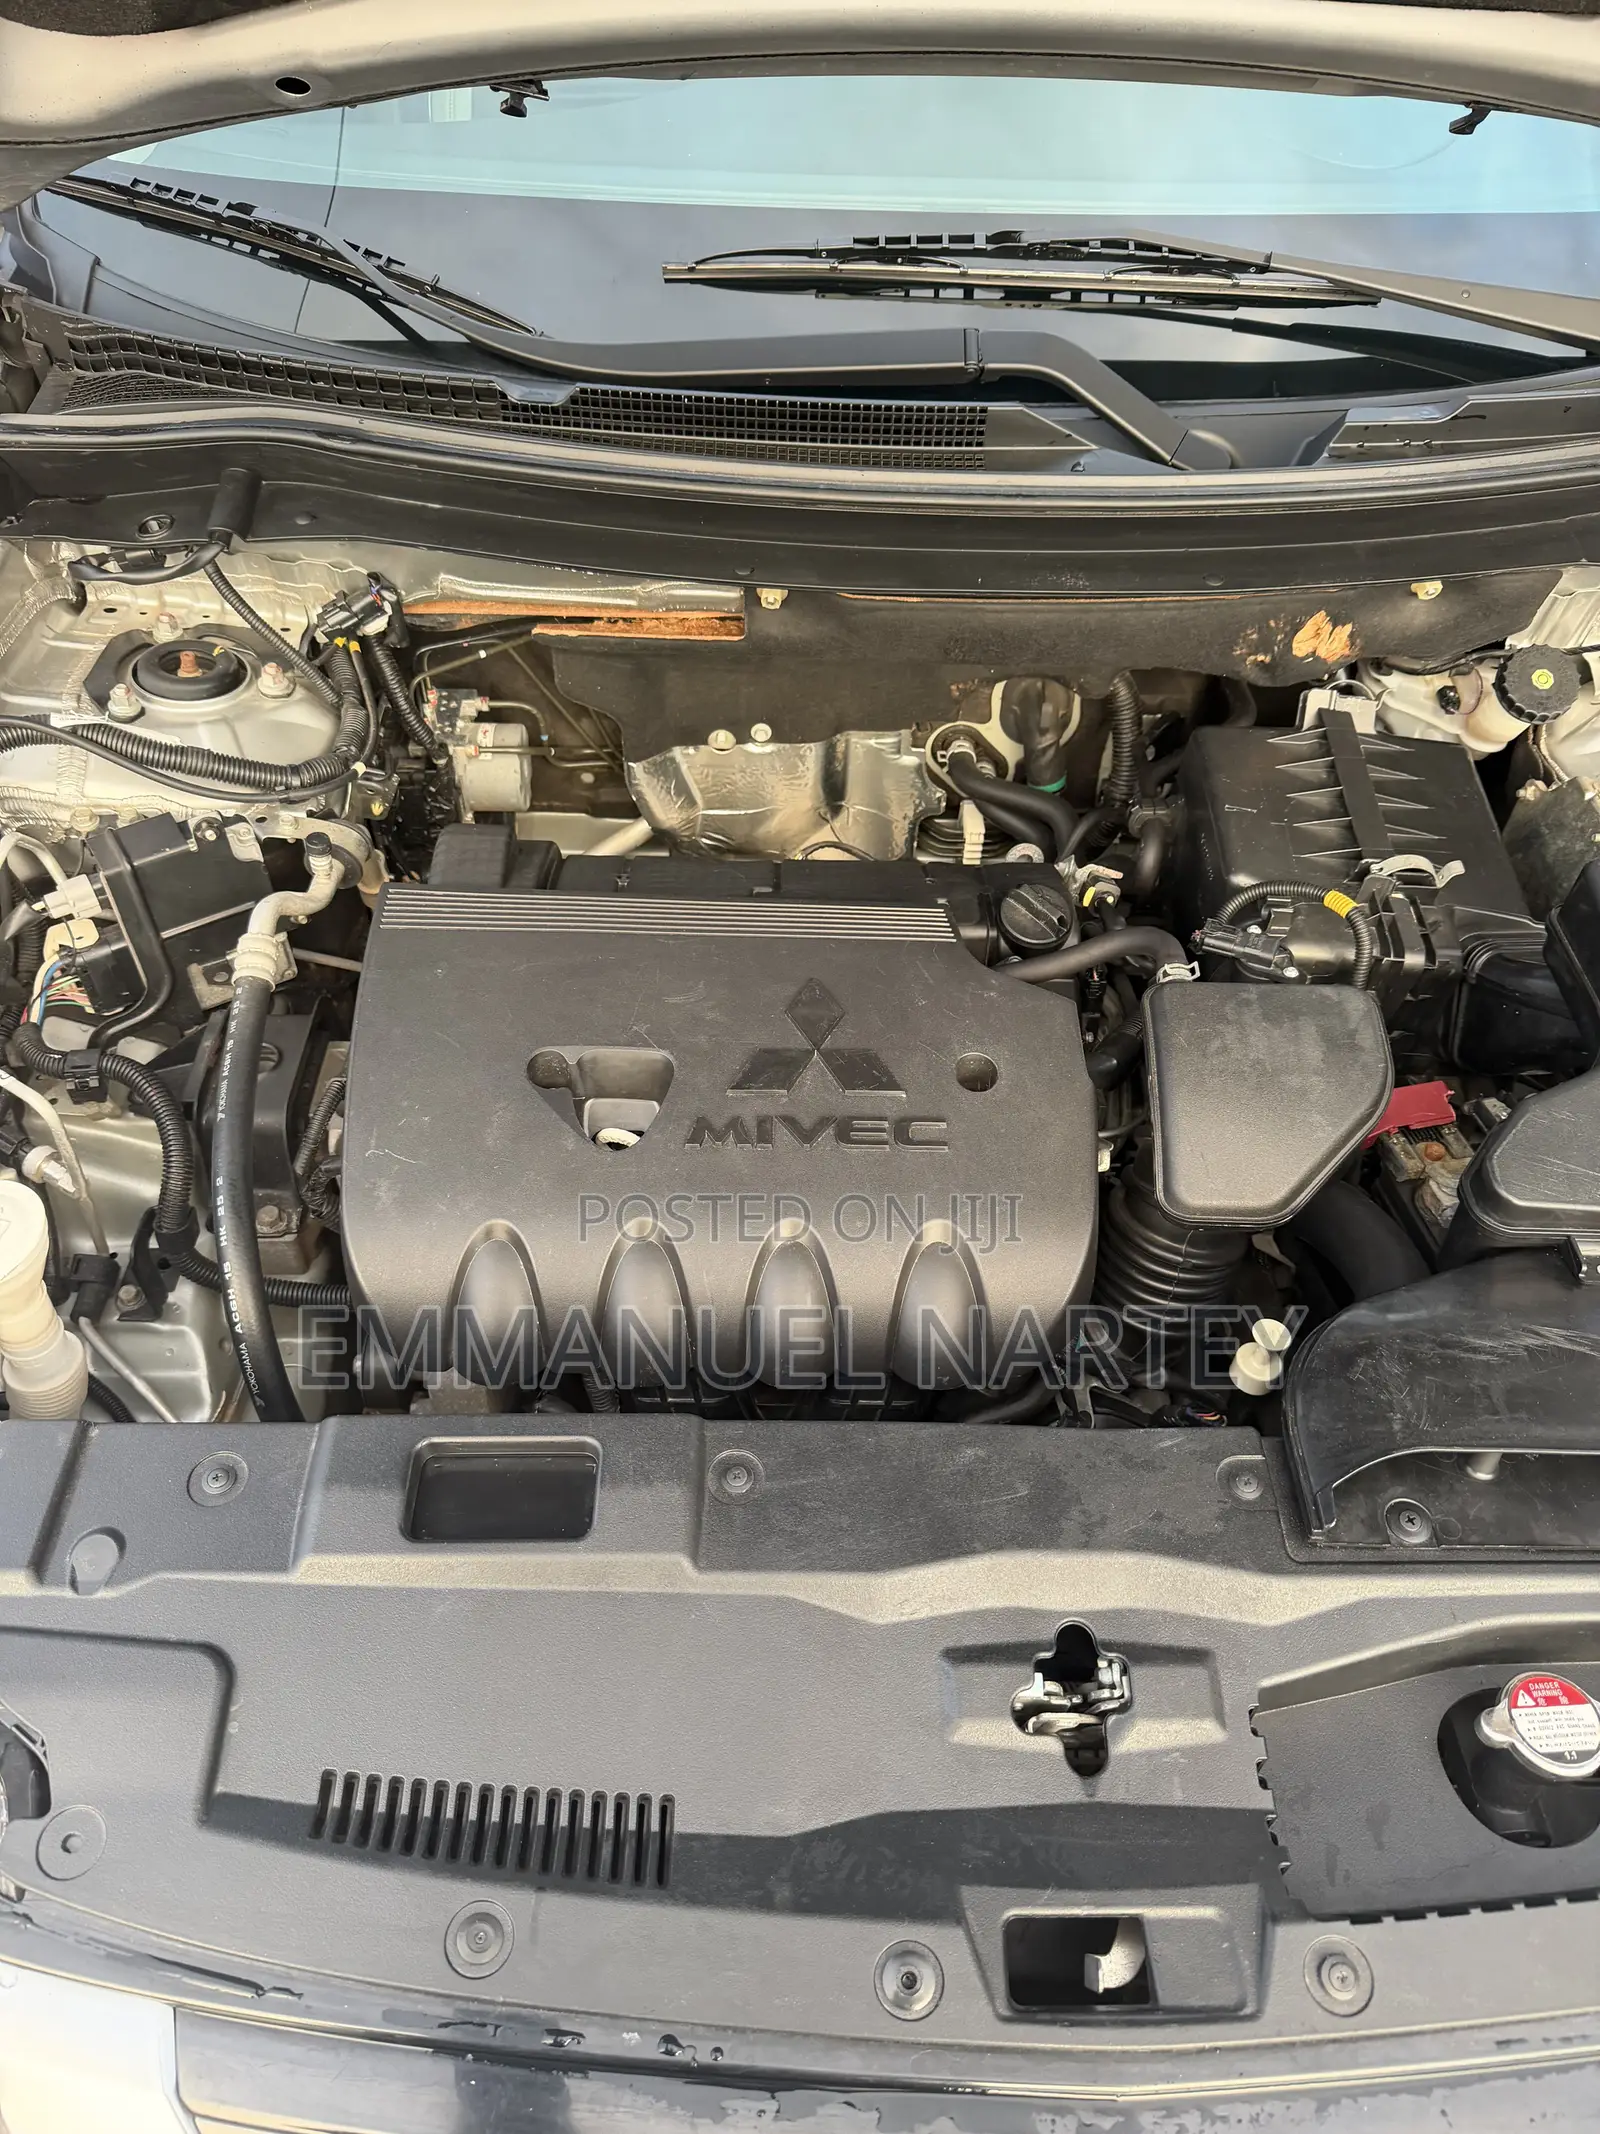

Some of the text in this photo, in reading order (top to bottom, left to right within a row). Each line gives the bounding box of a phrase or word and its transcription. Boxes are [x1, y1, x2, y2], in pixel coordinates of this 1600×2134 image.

[684, 1115, 949, 1151] MIVEC
[219, 1225, 228, 1247] HK
[223, 1261, 232, 1281] 15
[239, 1342, 260, 1394] YOKOHAMA
[1529, 1682, 1560, 1690] DANGER
[1532, 1689, 1563, 1697] WARNING
